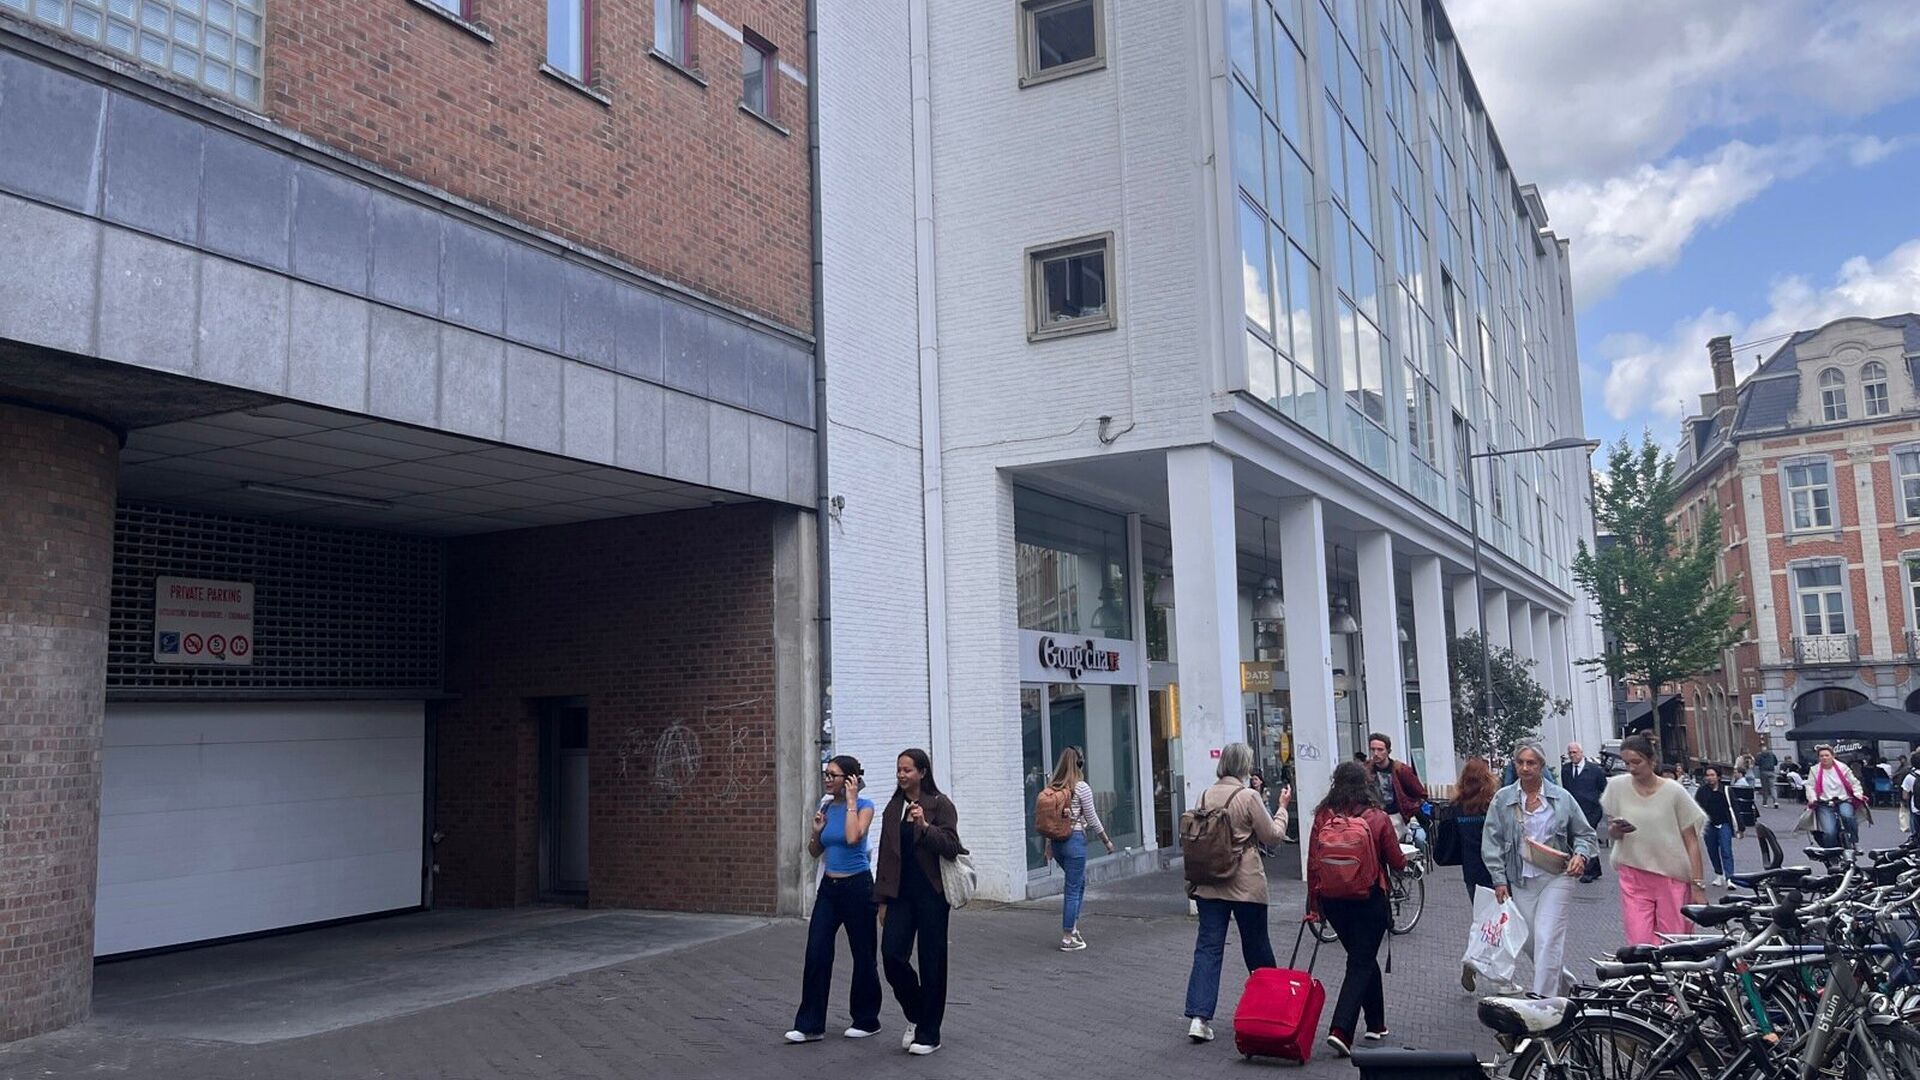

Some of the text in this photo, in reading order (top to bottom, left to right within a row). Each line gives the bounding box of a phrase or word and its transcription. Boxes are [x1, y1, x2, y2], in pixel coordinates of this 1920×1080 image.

[170, 585, 241, 603] PRIVATE PARKING
[1039, 636, 1084, 679] Gong
